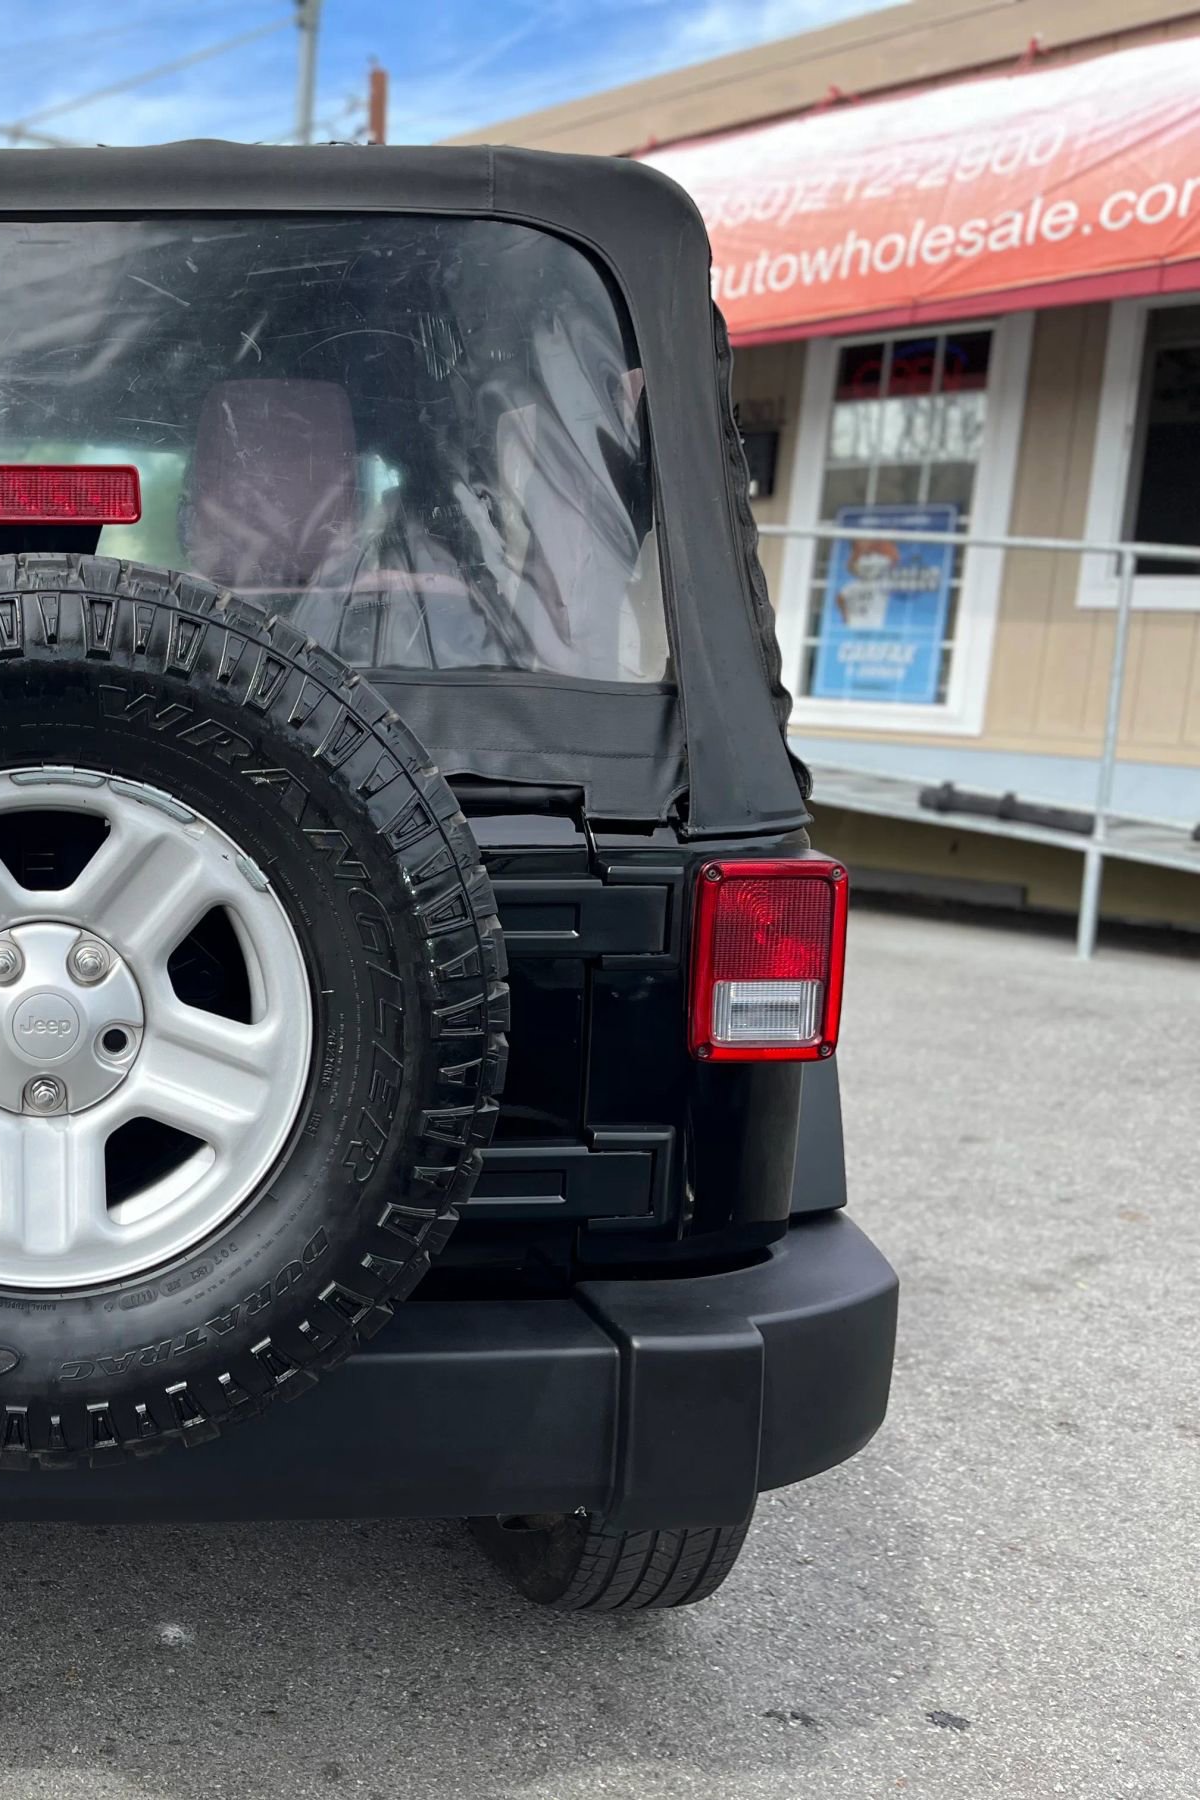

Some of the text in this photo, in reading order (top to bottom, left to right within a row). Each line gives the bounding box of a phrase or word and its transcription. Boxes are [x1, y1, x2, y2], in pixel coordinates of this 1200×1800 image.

[99, 684, 405, 1183] WRANGLER
[19, 1014, 72, 1038] Jeep
[59, 1225, 331, 1382] DURATRAC
